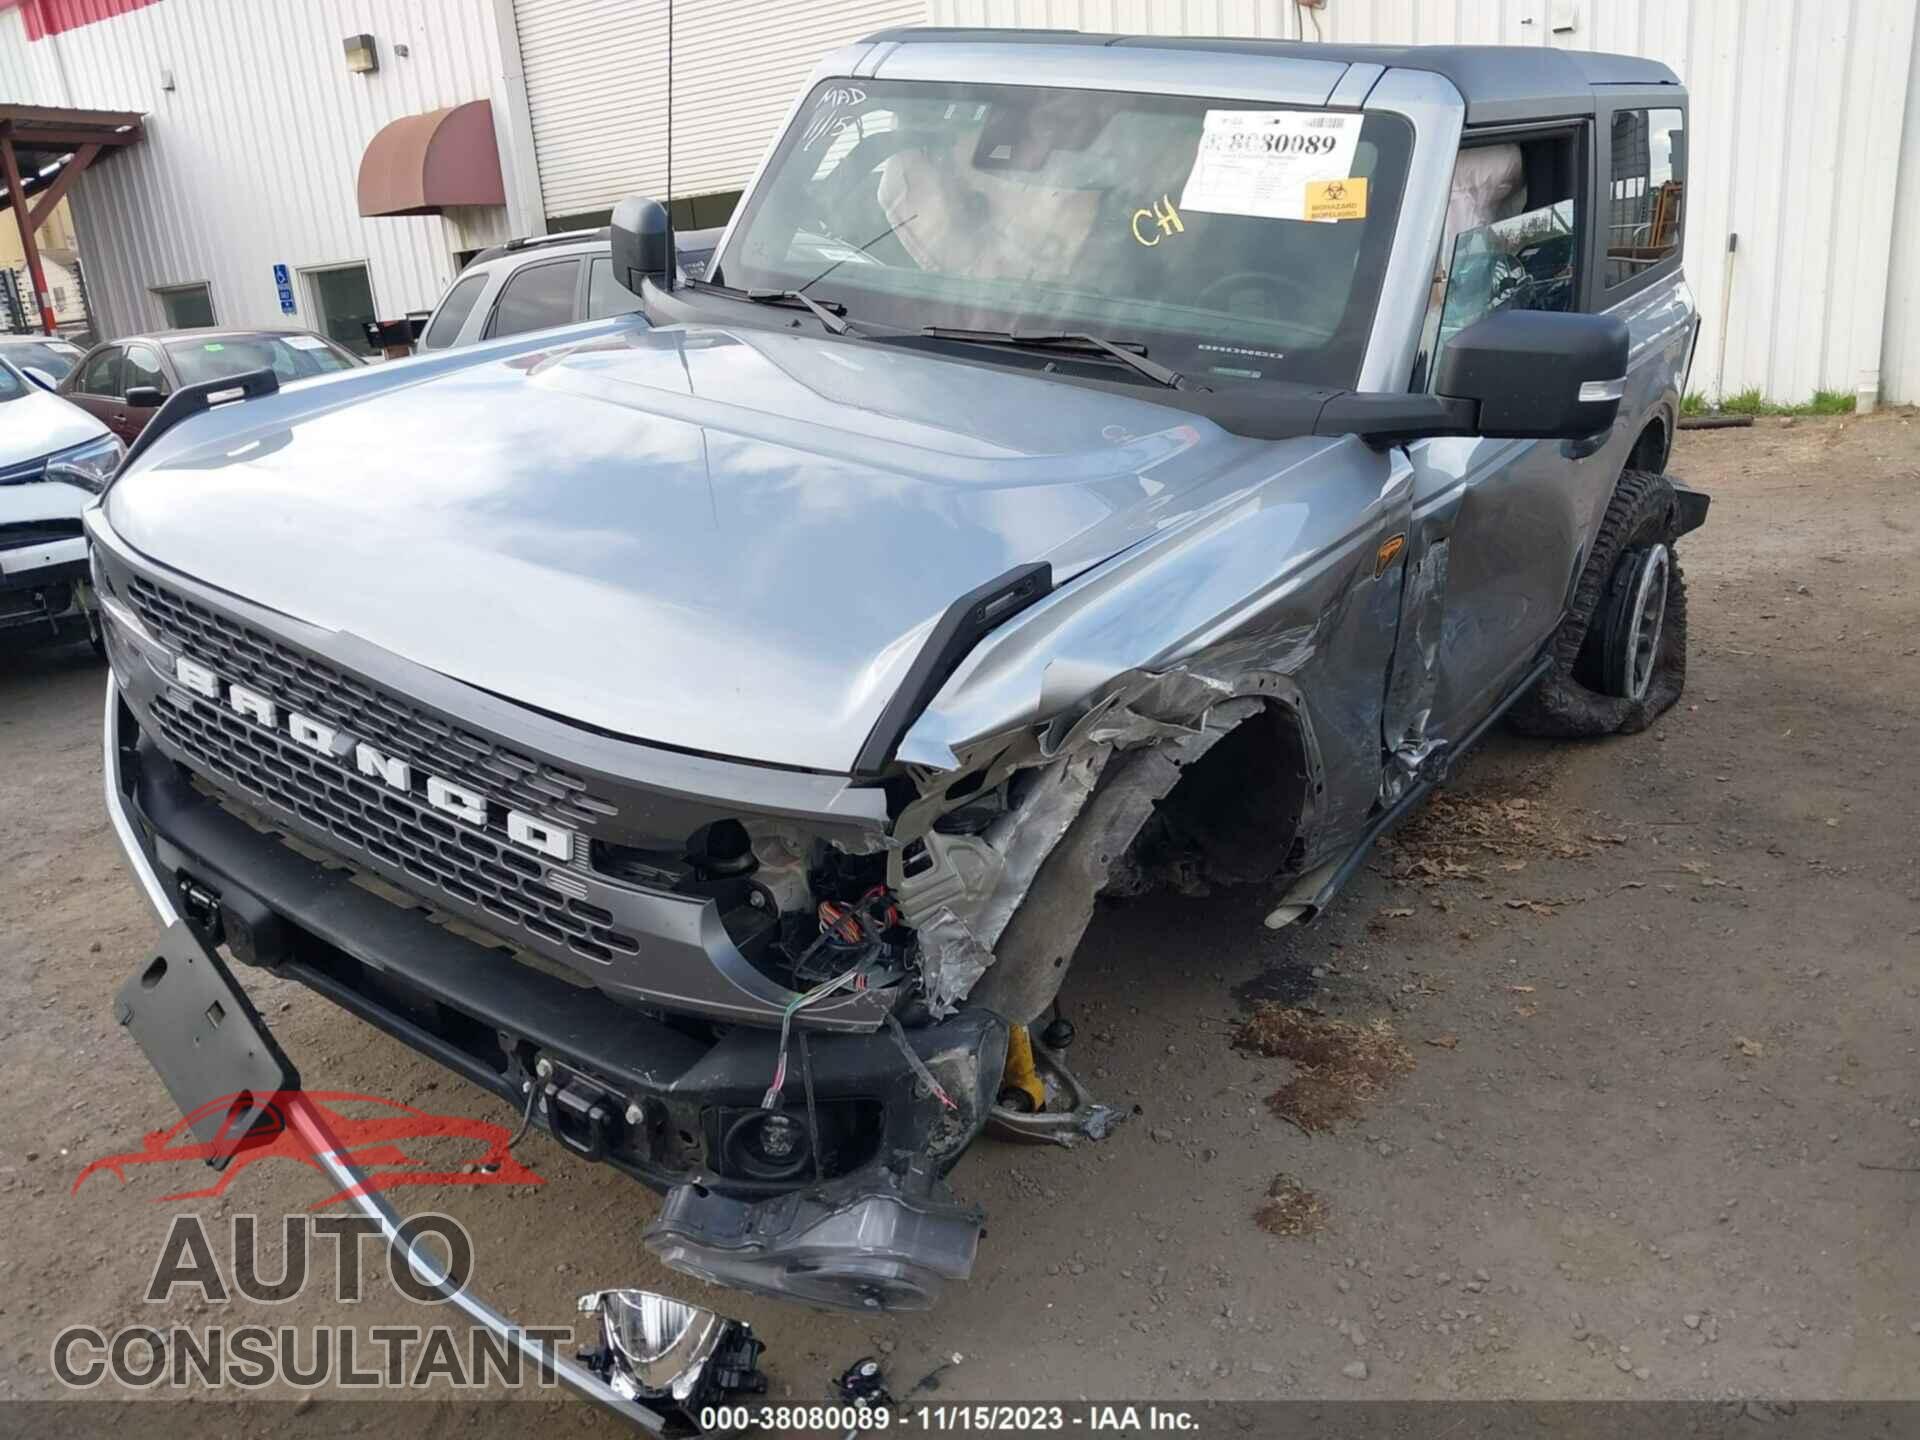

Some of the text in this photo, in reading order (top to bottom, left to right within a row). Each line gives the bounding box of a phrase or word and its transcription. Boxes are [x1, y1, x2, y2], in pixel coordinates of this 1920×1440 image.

[815, 86, 867, 109] MAD
[1132, 193, 1185, 246] CH
[175, 656, 575, 861] BRONCO
